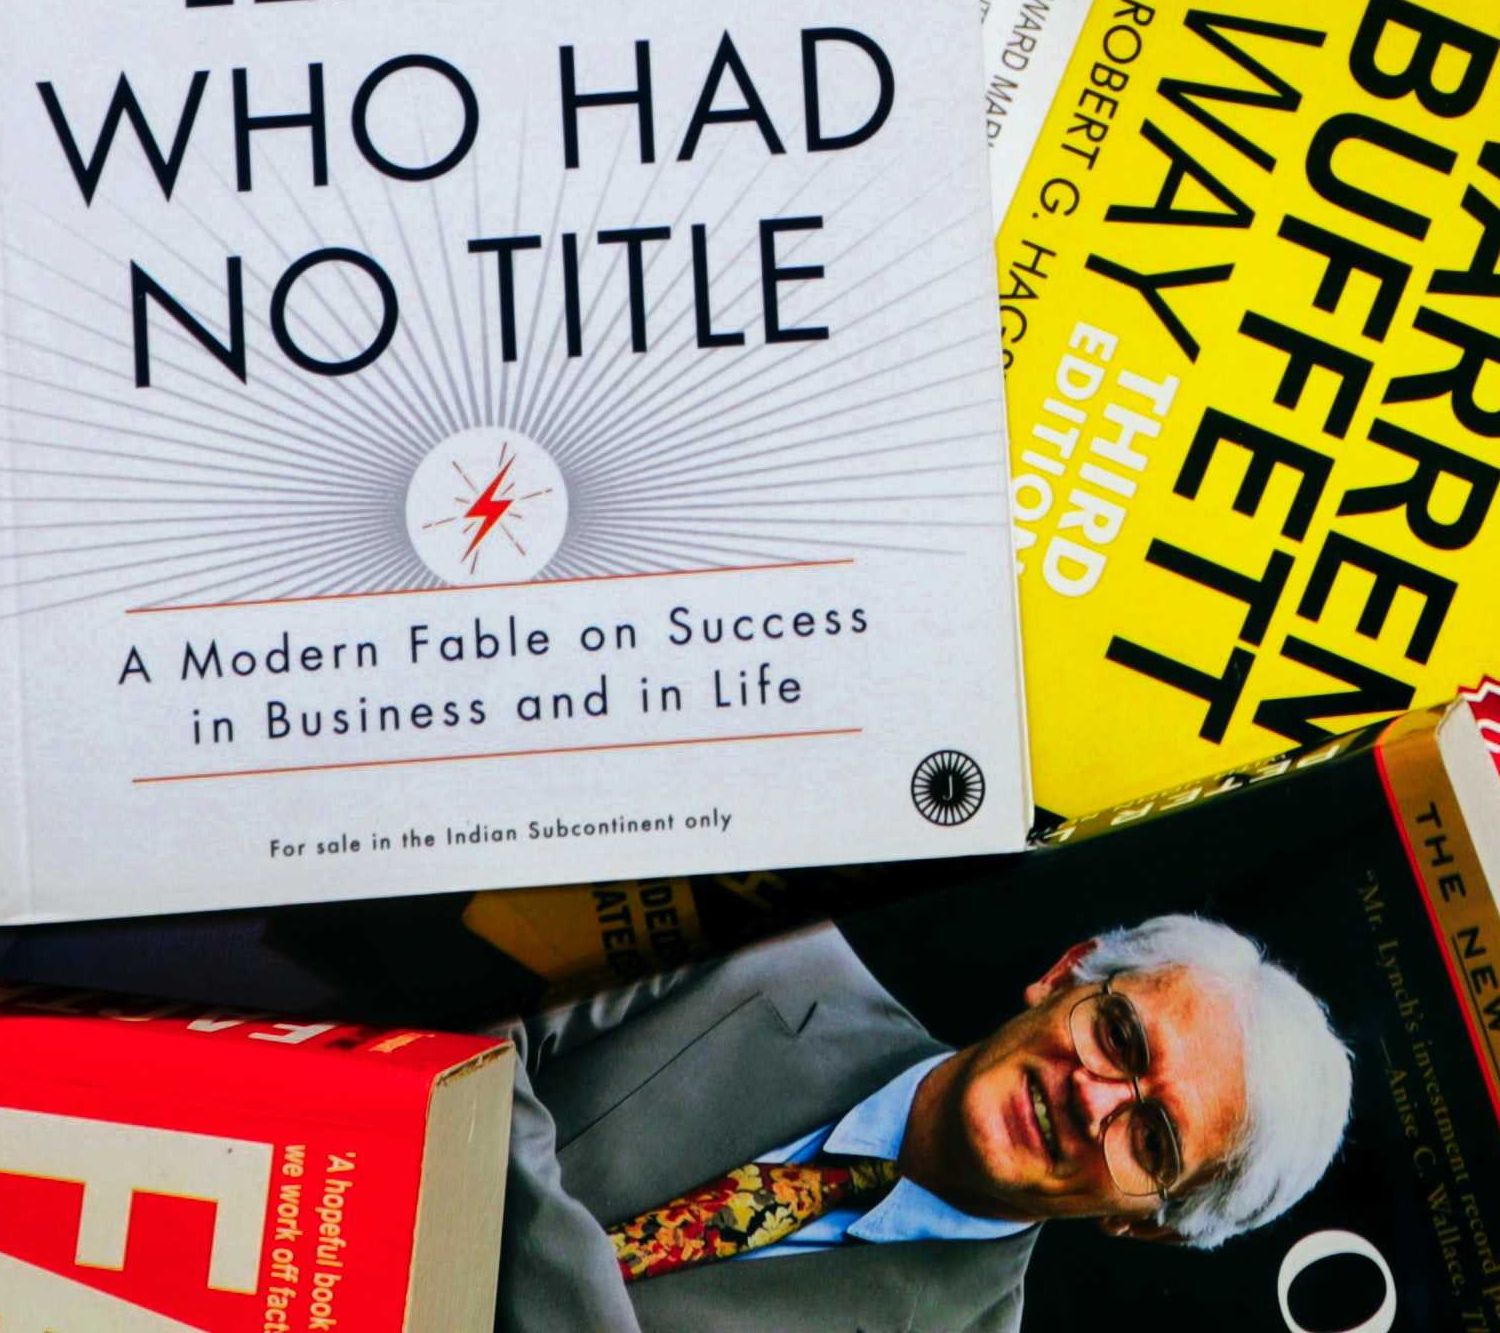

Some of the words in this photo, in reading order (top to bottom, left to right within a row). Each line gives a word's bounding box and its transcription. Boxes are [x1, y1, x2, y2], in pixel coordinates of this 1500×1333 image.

[35, 53, 480, 207] WHO
[558, 25, 895, 169] HAD
[1038, 176, 1084, 219] G.
[1085, 5, 1327, 362] WAY
[130, 246, 399, 388] NO
[467, 215, 829, 362] TITLE
[1041, 368, 1184, 600] THIRD
[117, 644, 151, 685] A
[180, 631, 377, 680] Modern
[409, 614, 549, 664] Fable
[579, 623, 636, 652] on
[668, 605, 867, 646] Success
[269, 838, 306, 858] For
[316, 832, 361, 855] sale
[371, 832, 391, 850] in
[401, 828, 435, 848] the
[446, 823, 517, 845] Indian
[528, 813, 674, 840] Subcontinent
[684, 806, 732, 832] only
